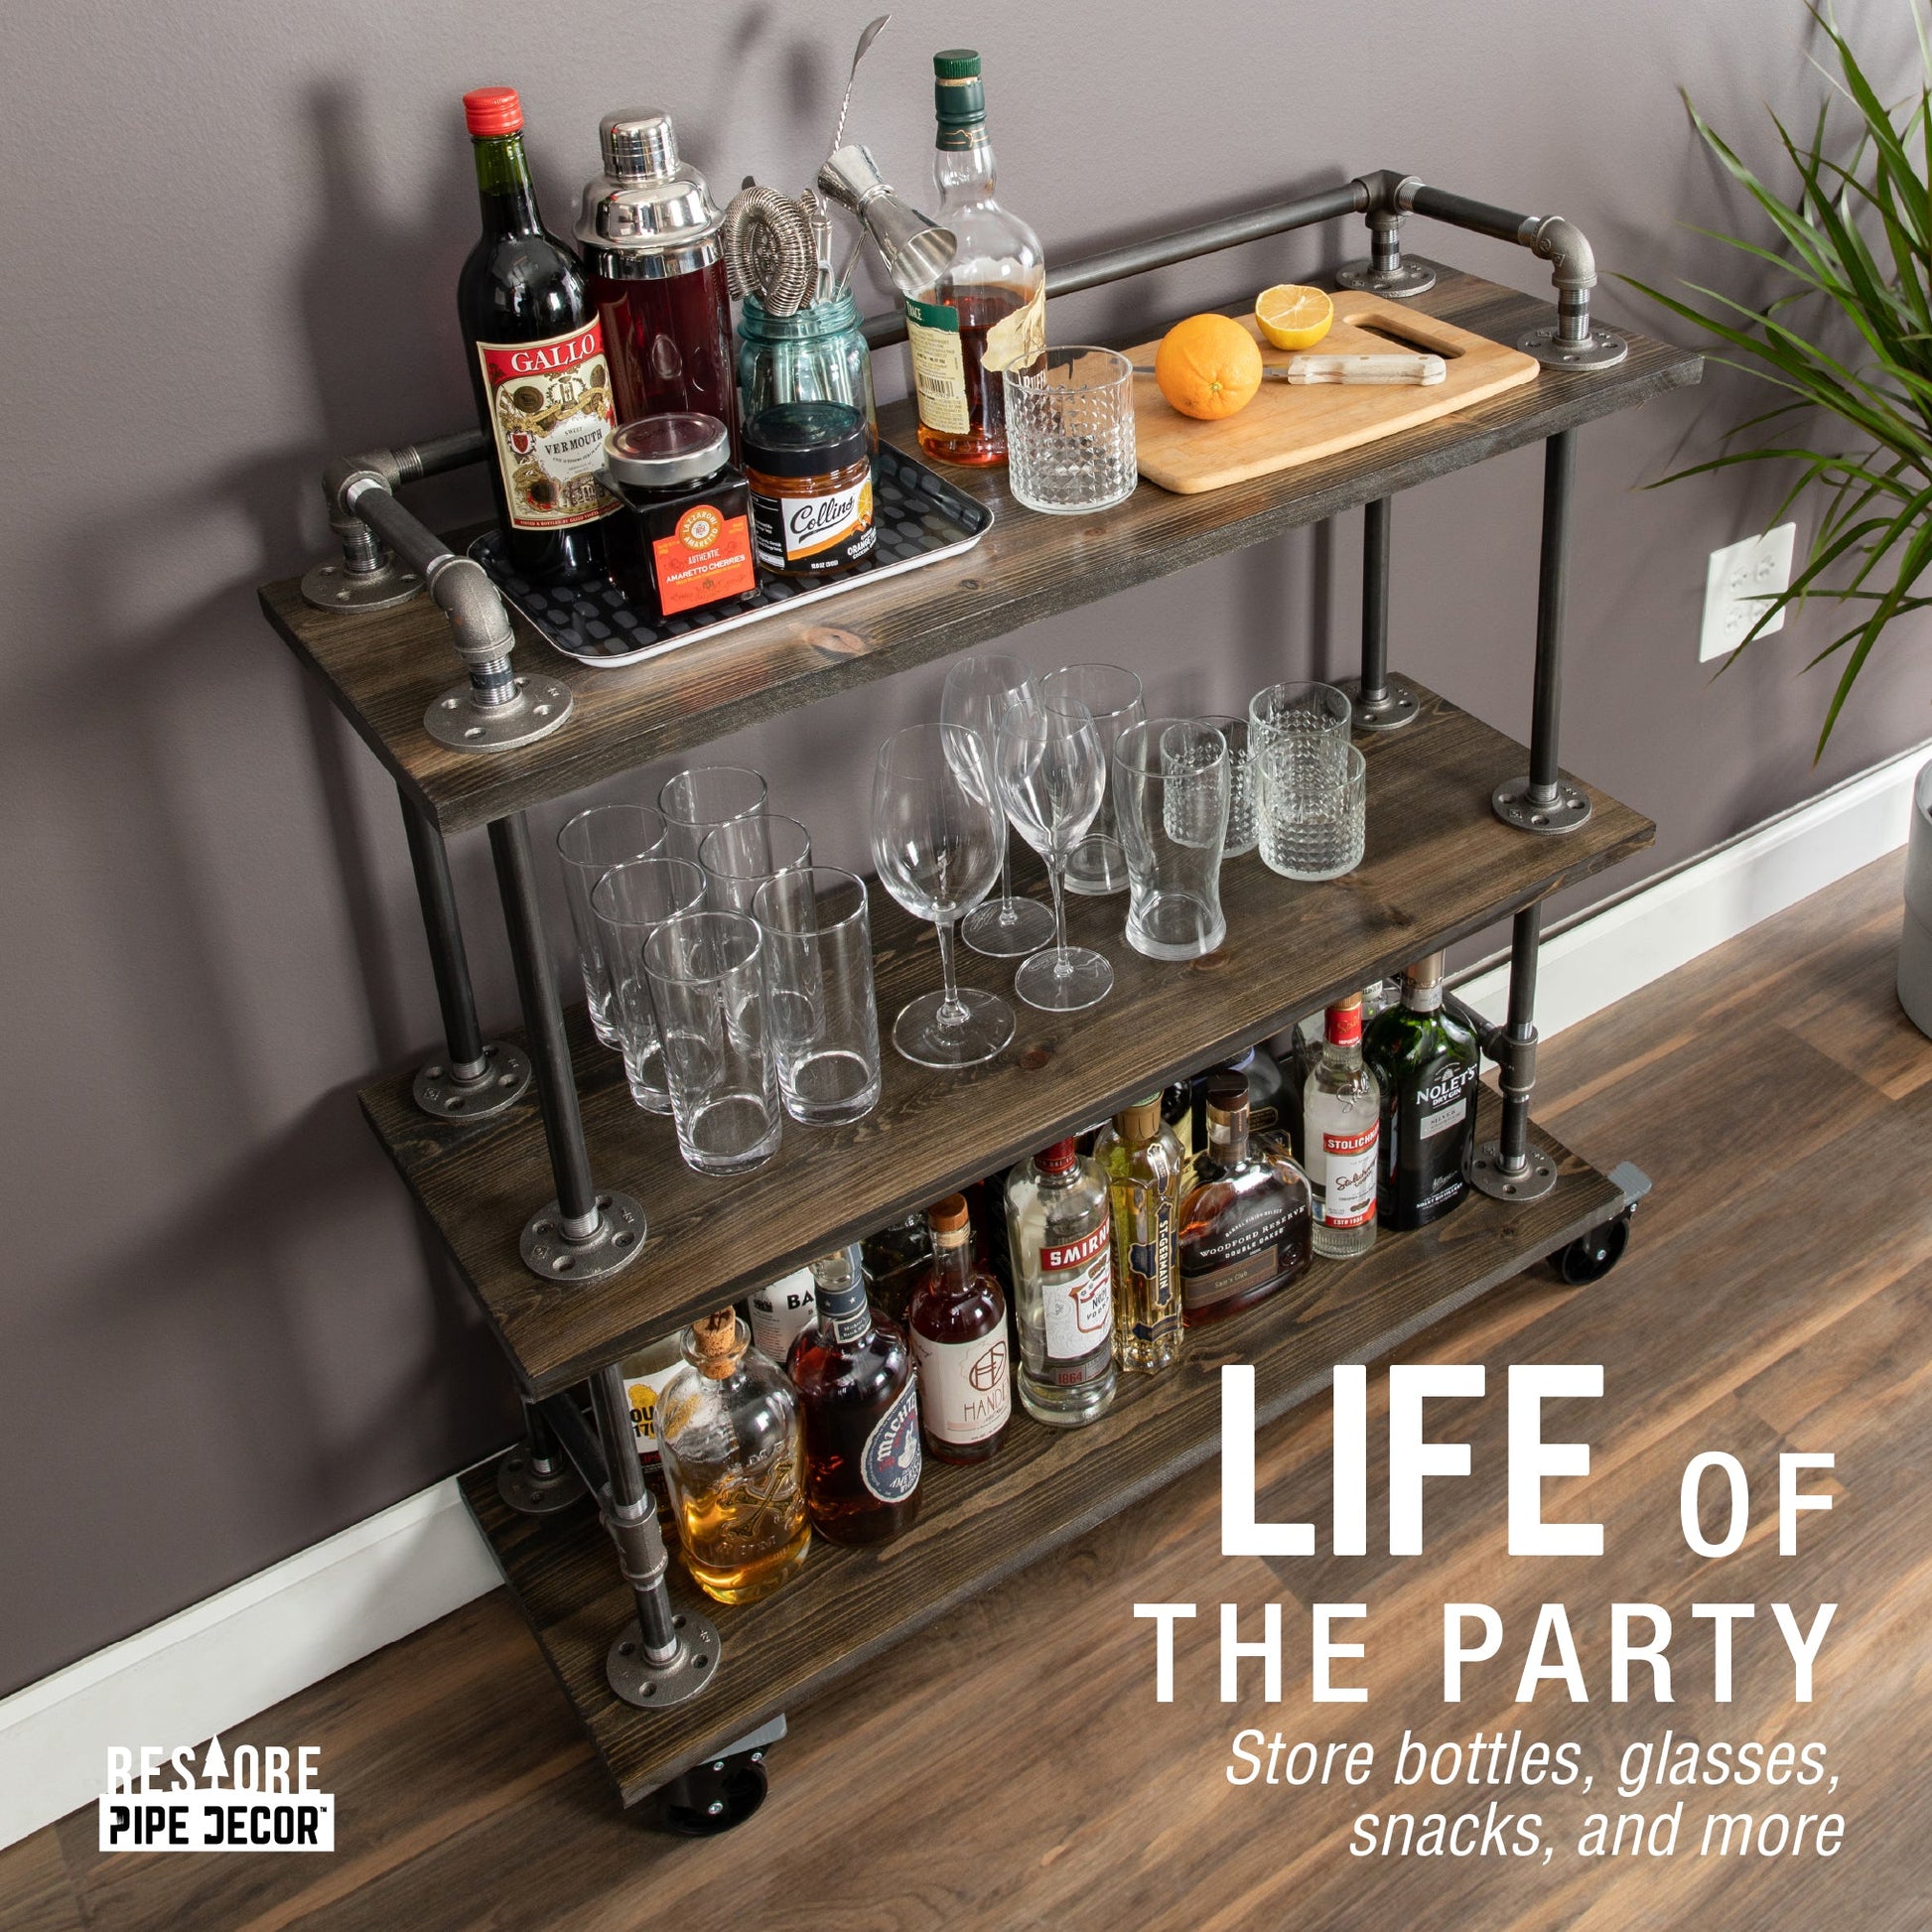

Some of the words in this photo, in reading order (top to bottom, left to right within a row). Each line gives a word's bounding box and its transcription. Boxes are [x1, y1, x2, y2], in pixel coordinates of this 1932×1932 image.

[511, 334, 596, 372] GALLO
[544, 428, 603, 455] VERMOUTH
[789, 495, 855, 543] Collins
[666, 565, 708, 584] AMARETTO
[708, 554, 746, 571] CHERRIES
[1416, 1063, 1477, 1105] NOLET'S
[1433, 1095, 1449, 1106] DRY
[1449, 1087, 1461, 1099] GIN
[1049, 1215, 1110, 1267] SMIRN
[1199, 1231, 1259, 1258] WOODFORD
[1262, 1204, 1306, 1233] RESERVE
[1225, 1242, 1256, 1258] DOUBLE
[1259, 1227, 1285, 1244] OAKED
[1159, 1219, 1169, 1290] ST-GERMAIN
[1234, 1271, 1248, 1281] Club
[786, 1290, 815, 1311] BA
[1058, 1371, 1084, 1385] 1864
